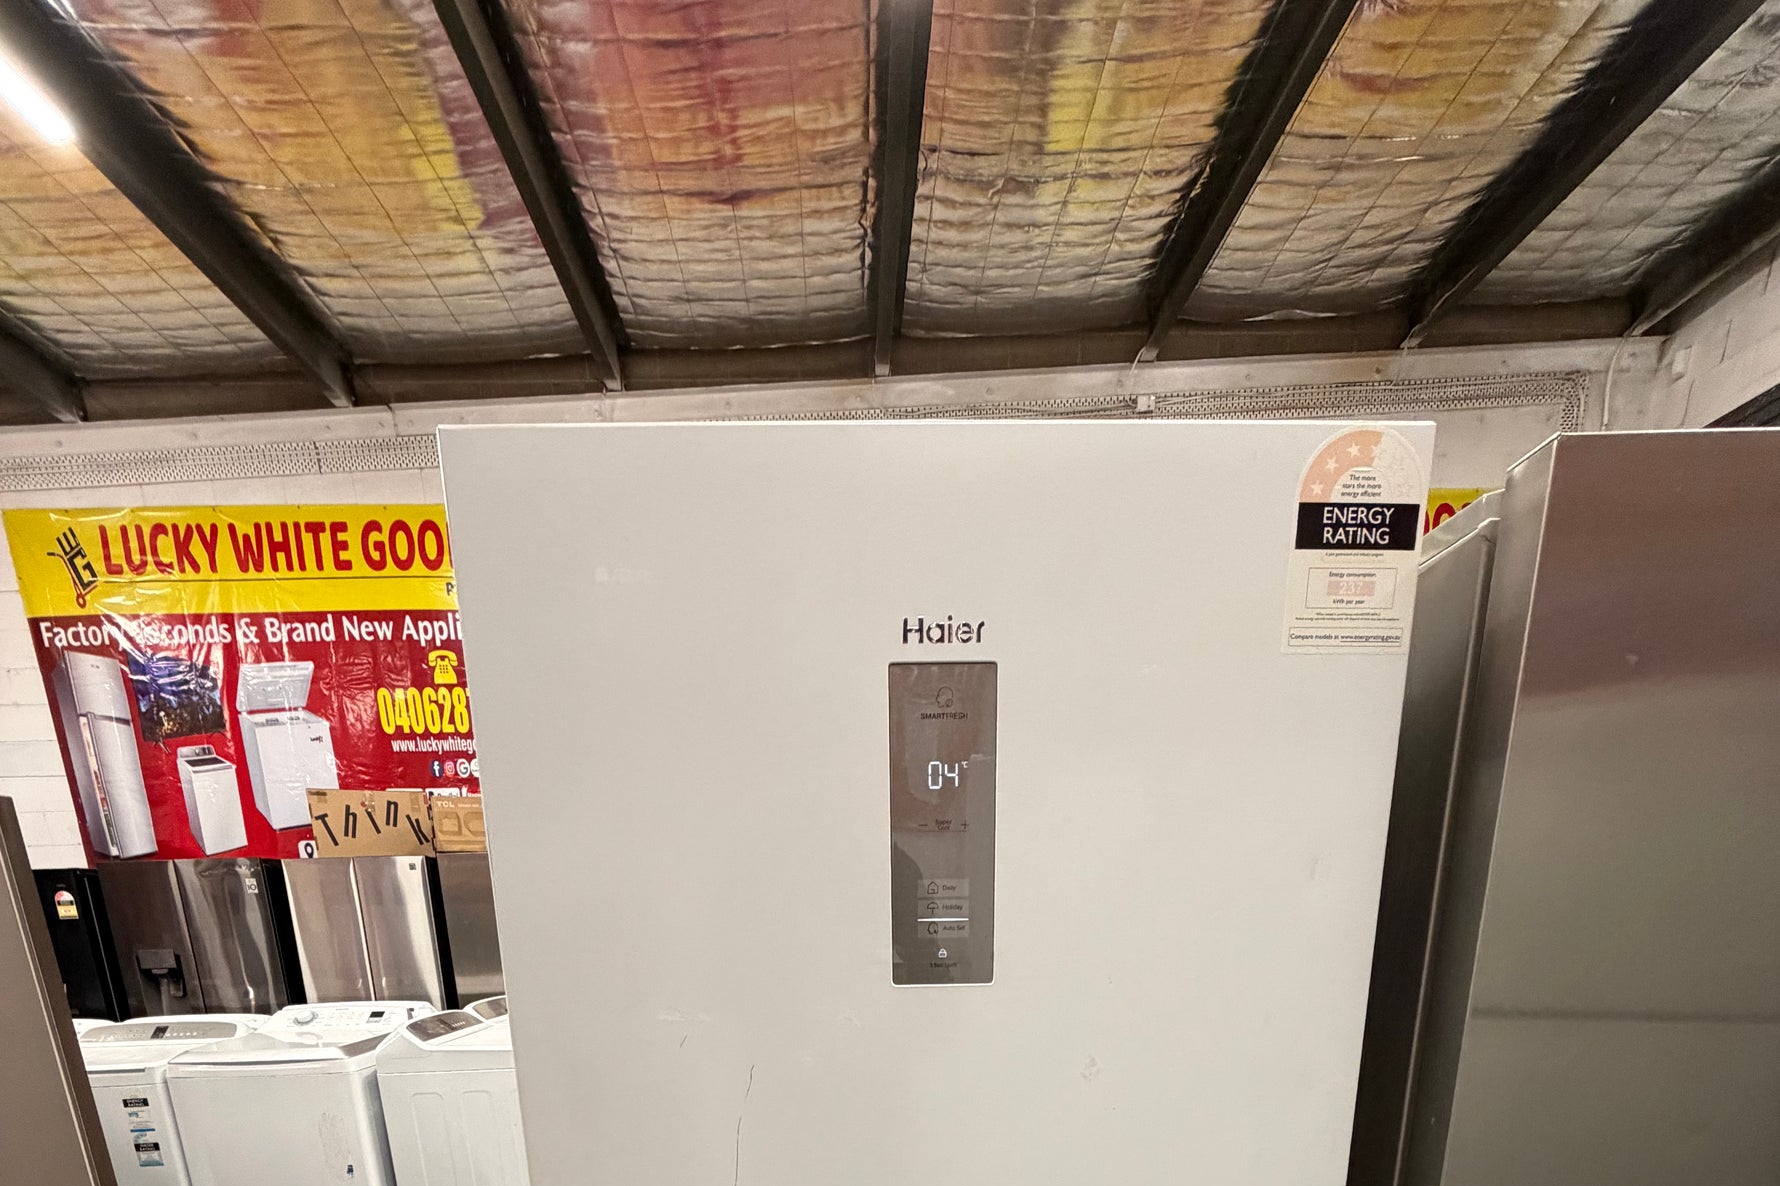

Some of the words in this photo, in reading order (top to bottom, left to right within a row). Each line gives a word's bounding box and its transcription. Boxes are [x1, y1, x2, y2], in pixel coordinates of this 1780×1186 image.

[1323, 507, 1395, 524] ENERGY
[98, 522, 218, 576] LUCKY
[227, 521, 353, 574] WHITE
[361, 519, 454, 572] GOO
[1323, 527, 1390, 544] RATING
[239, 617, 260, 643] &
[264, 614, 337, 643] Brand
[342, 615, 393, 642] New
[902, 615, 985, 644] Haier
[377, 687, 470, 735] 040628
[436, 800, 455, 808] TCL
[315, 799, 430, 846] Think
